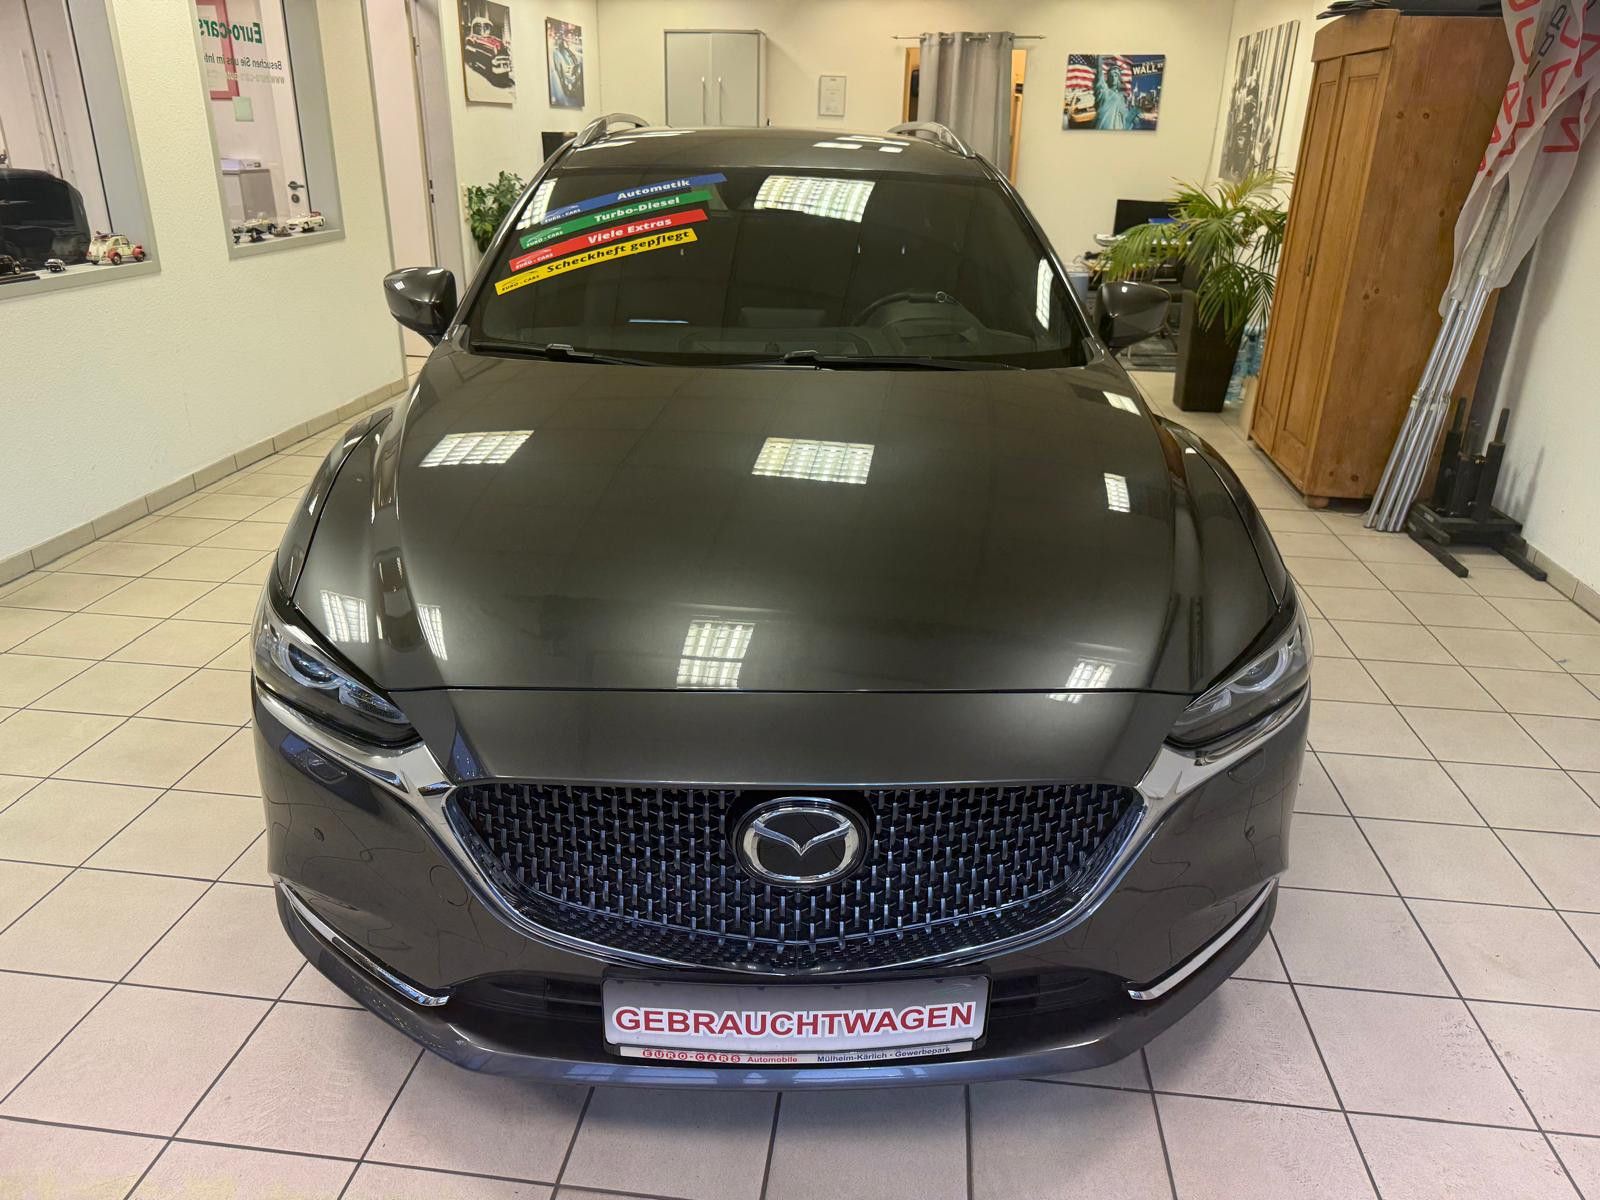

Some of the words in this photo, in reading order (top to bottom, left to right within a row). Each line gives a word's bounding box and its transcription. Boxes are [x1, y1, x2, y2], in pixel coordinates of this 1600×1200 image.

[1132, 64, 1158, 75] WALL
[617, 179, 691, 201] Automatik
[593, 196, 680, 224] Turbo-Diesel
[587, 228, 625, 245] Viele
[627, 217, 673, 234] Extras
[546, 243, 626, 273] Scheckheft
[630, 231, 690, 254] gepflegt
[613, 1003, 974, 1036] GEBRAUCHTWAGEN
[642, 1049, 741, 1063] EURO-CARS
[747, 1055, 798, 1064] Automobile
[817, 1051, 887, 1063] Mülheim-Kärlich
[894, 1045, 951, 1058] Gewerbepark
